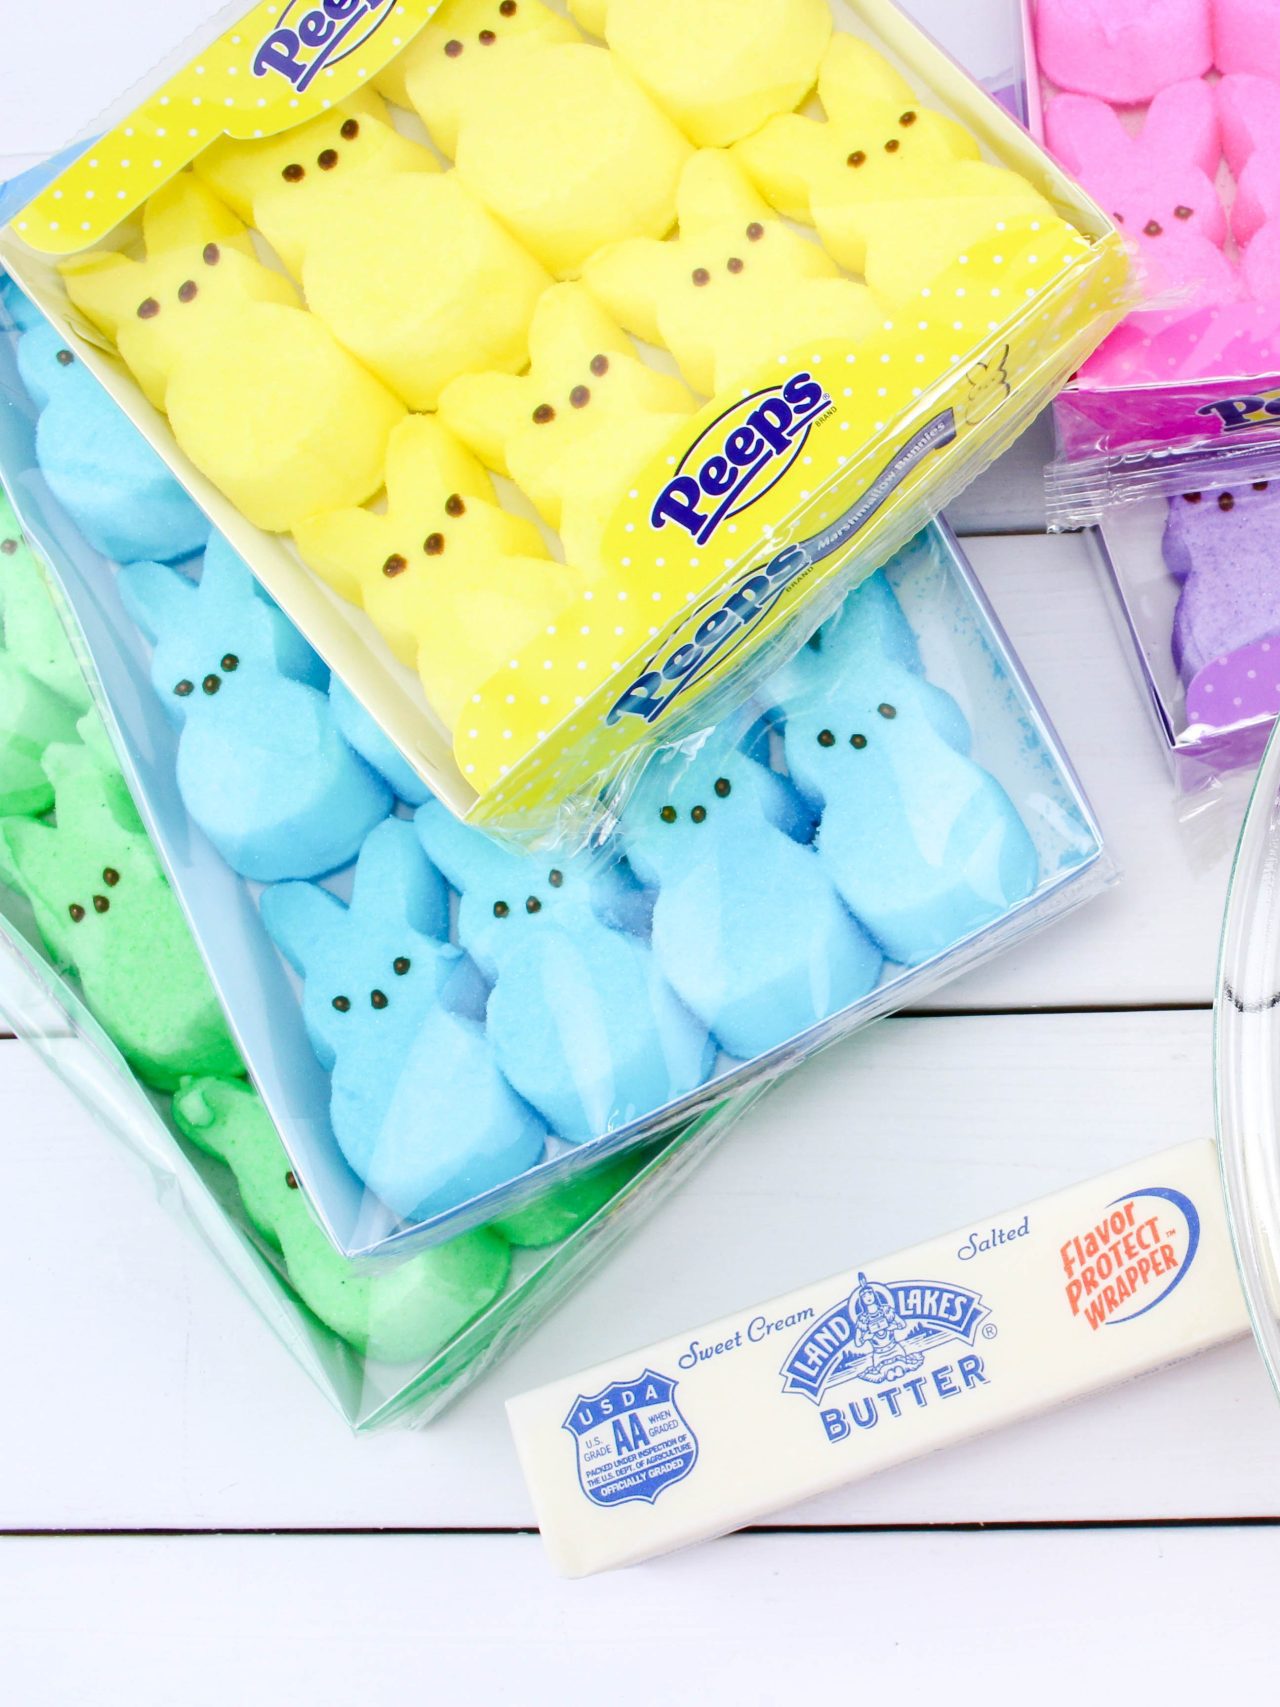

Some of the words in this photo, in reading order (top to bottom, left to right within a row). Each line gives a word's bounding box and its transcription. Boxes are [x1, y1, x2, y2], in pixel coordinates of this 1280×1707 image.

[253, 0, 383, 85] Pee
[814, 405, 838, 428] BRAND
[651, 373, 823, 535] Peeps
[817, 470, 897, 551] Marshmallow
[894, 421, 946, 472] Bunnies
[785, 566, 814, 593] BRAND
[606, 544, 806, 726] Peeps
[957, 1216, 1031, 1261] Salted
[1060, 1201, 1135, 1279] Flavor
[1065, 1216, 1161, 1317] PROTECT
[1084, 1244, 1178, 1331] WRAPPER
[678, 1332, 743, 1369] Sweet
[747, 1308, 815, 1342] Cream
[793, 1315, 850, 1378] LAND
[897, 1289, 969, 1322] LAKES
[578, 1385, 658, 1425] USDA
[648, 1410, 671, 1425] WHEN
[819, 1354, 991, 1443] BUTTER
[585, 1436, 603, 1449] U.S.
[611, 1412, 650, 1456] AA
[648, 1419, 679, 1437] GRADED
[583, 1445, 612, 1462] GRADE
[586, 1463, 613, 1478] PACKED
[614, 1453, 638, 1468] UNDER
[638, 1439, 677, 1459] INSPECTION
[678, 1434, 688, 1444] OF
[587, 1478, 600, 1488] THE
[600, 1472, 615, 1483] U.S.
[616, 1466, 635, 1478] DEPT.
[635, 1459, 646, 1469] OF
[646, 1442, 692, 1466] AGRICULTURE
[600, 1471, 648, 1497] OFFICIALLY
[649, 1458, 684, 1478] GRADED
